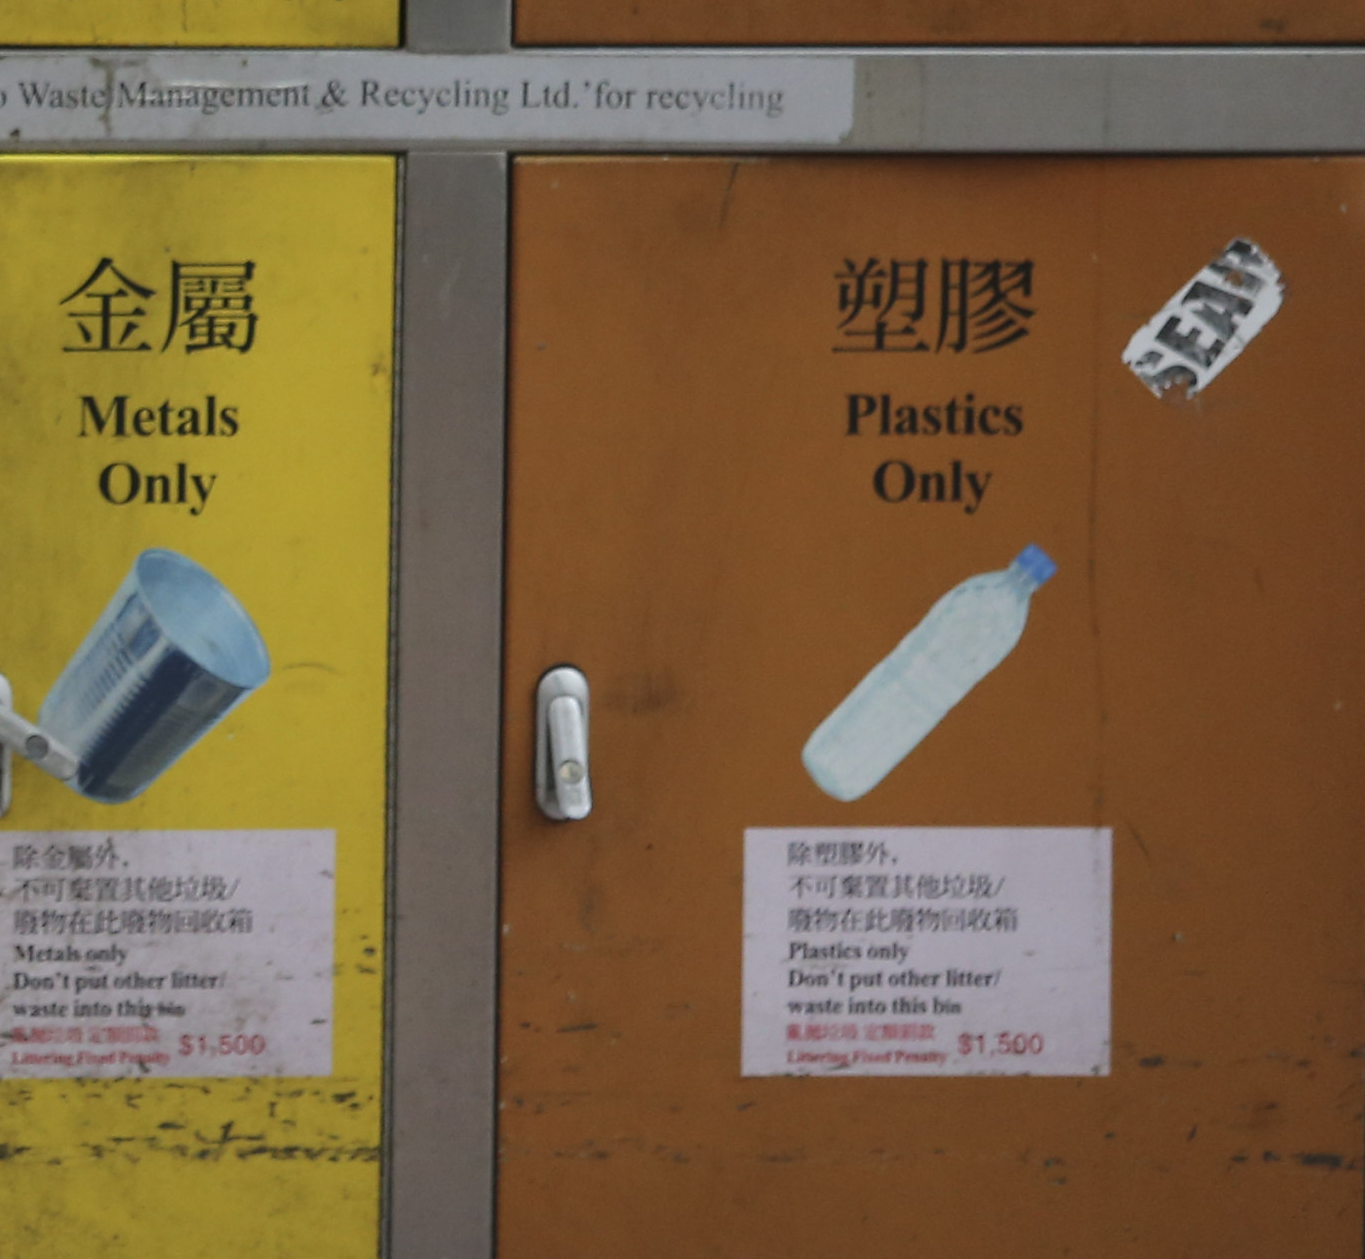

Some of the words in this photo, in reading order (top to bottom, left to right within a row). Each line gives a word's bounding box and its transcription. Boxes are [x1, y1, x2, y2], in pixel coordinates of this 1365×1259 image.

[17, 82, 109, 110] Waste
[117, 80, 311, 116] Management
[319, 82, 348, 110] &
[360, 82, 510, 117] Recycling
[645, 82, 785, 117] recycling
[58, 255, 260, 356] 金屬
[831, 256, 1040, 356] 塑膠
[77, 394, 240, 439] Metals
[844, 392, 1025, 438] Plastics
[97, 461, 217, 517] Only
[871, 458, 993, 515] Only
[13, 945, 81, 963] Metals
[85, 945, 129, 967] only
[788, 942, 862, 960] Plastics
[866, 942, 910, 964] only
[13, 972, 70, 989] Don't
[75, 972, 109, 994] put
[113, 972, 167, 989] other
[787, 970, 845, 987] Don't
[850, 970, 883, 991] put
[888, 970, 940, 987] other
[12, 1002, 68, 1018] waste
[73, 1002, 112, 1018] into
[117, 1002, 151, 1018] this
[157, 1002, 186, 1018] bin
[787, 999, 843, 1015] waste
[847, 999, 887, 1015] into
[892, 999, 927, 1015] this
[933, 999, 963, 1015] bin
[178, 1034, 266, 1057] $1,500
[956, 1032, 1045, 1056] $1,500
